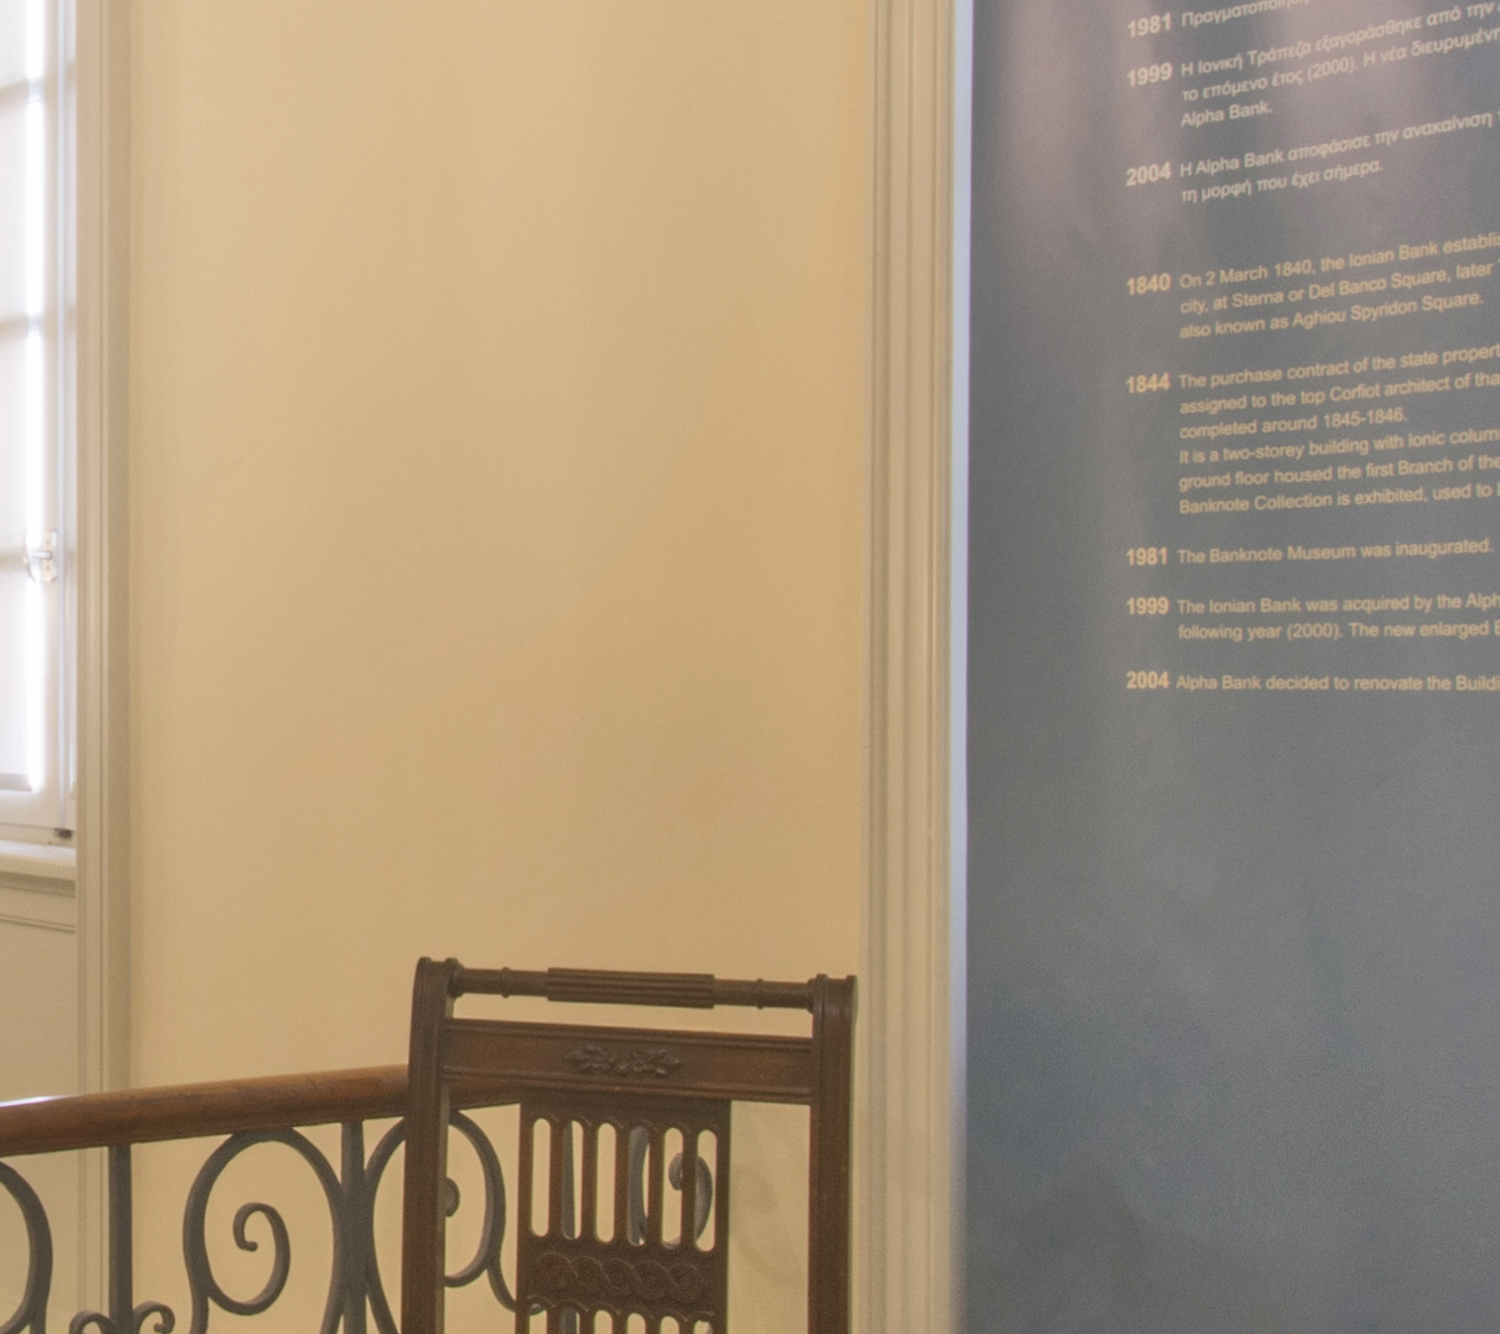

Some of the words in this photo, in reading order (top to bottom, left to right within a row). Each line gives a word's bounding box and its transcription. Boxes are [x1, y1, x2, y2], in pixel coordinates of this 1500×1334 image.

[1126, 11, 1173, 39] 1981
[1178, 108, 1226, 129] Alpha
[1228, 98, 1274, 121] Bank.
[1123, 160, 1173, 188] 2004
[1193, 156, 1241, 177] Alpha
[1243, 147, 1285, 169] Bank
[1287, 134, 1372, 161] αποφάσισε
[1373, 128, 1400, 146] την
[1401, 111, 1492, 140] ανακαίνιση
[1124, 271, 1171, 296] 1840
[1179, 273, 1202, 289] On
[1205, 270, 1216, 286] 2
[1219, 263, 1268, 284] March
[1273, 258, 1316, 278] 1840,
[1319, 255, 1346, 272] the
[1348, 248, 1395, 268] Ionian
[1397, 239, 1440, 261] Bank
[1178, 323, 1212, 339] also
[1214, 318, 1265, 336] known
[1269, 316, 1290, 330] as
[1290, 308, 1347, 330] Aghiou
[1349, 299, 1418, 323] Spyridon
[1421, 292, 1484, 313] Square.
[1178, 418, 1257, 440] completed
[1261, 413, 1318, 433] around
[1179, 448, 1190, 464] It
[1191, 448, 1206, 463] is
[1208, 449, 1220, 462] a
[1221, 443, 1305, 462] two-storey
[1309, 437, 1369, 456] building
[1371, 433, 1404, 451] with
[1407, 429, 1446, 448] Ionic
[1125, 545, 1170, 566] 1981
[1175, 548, 1207, 565] The
[1208, 546, 1283, 563] Banknote
[1287, 545, 1356, 561] Museum
[1358, 544, 1393, 558] was
[1393, 535, 1494, 559] inaugurated.
[1177, 623, 1243, 643] following
[1245, 626, 1283, 642] year
[1286, 622, 1344, 642] (2000).
[1347, 621, 1380, 638] The
[1383, 624, 1417, 638] new
[1417, 619, 1489, 640] enlarged
[1124, 670, 1170, 690] 2004
[1174, 674, 1219, 693] Alpha
[1221, 673, 1262, 690] Bank
[1264, 674, 1329, 690] decided
[1332, 675, 1350, 690] to
[1353, 675, 1424, 691] renovate
[1425, 674, 1452, 691] the
